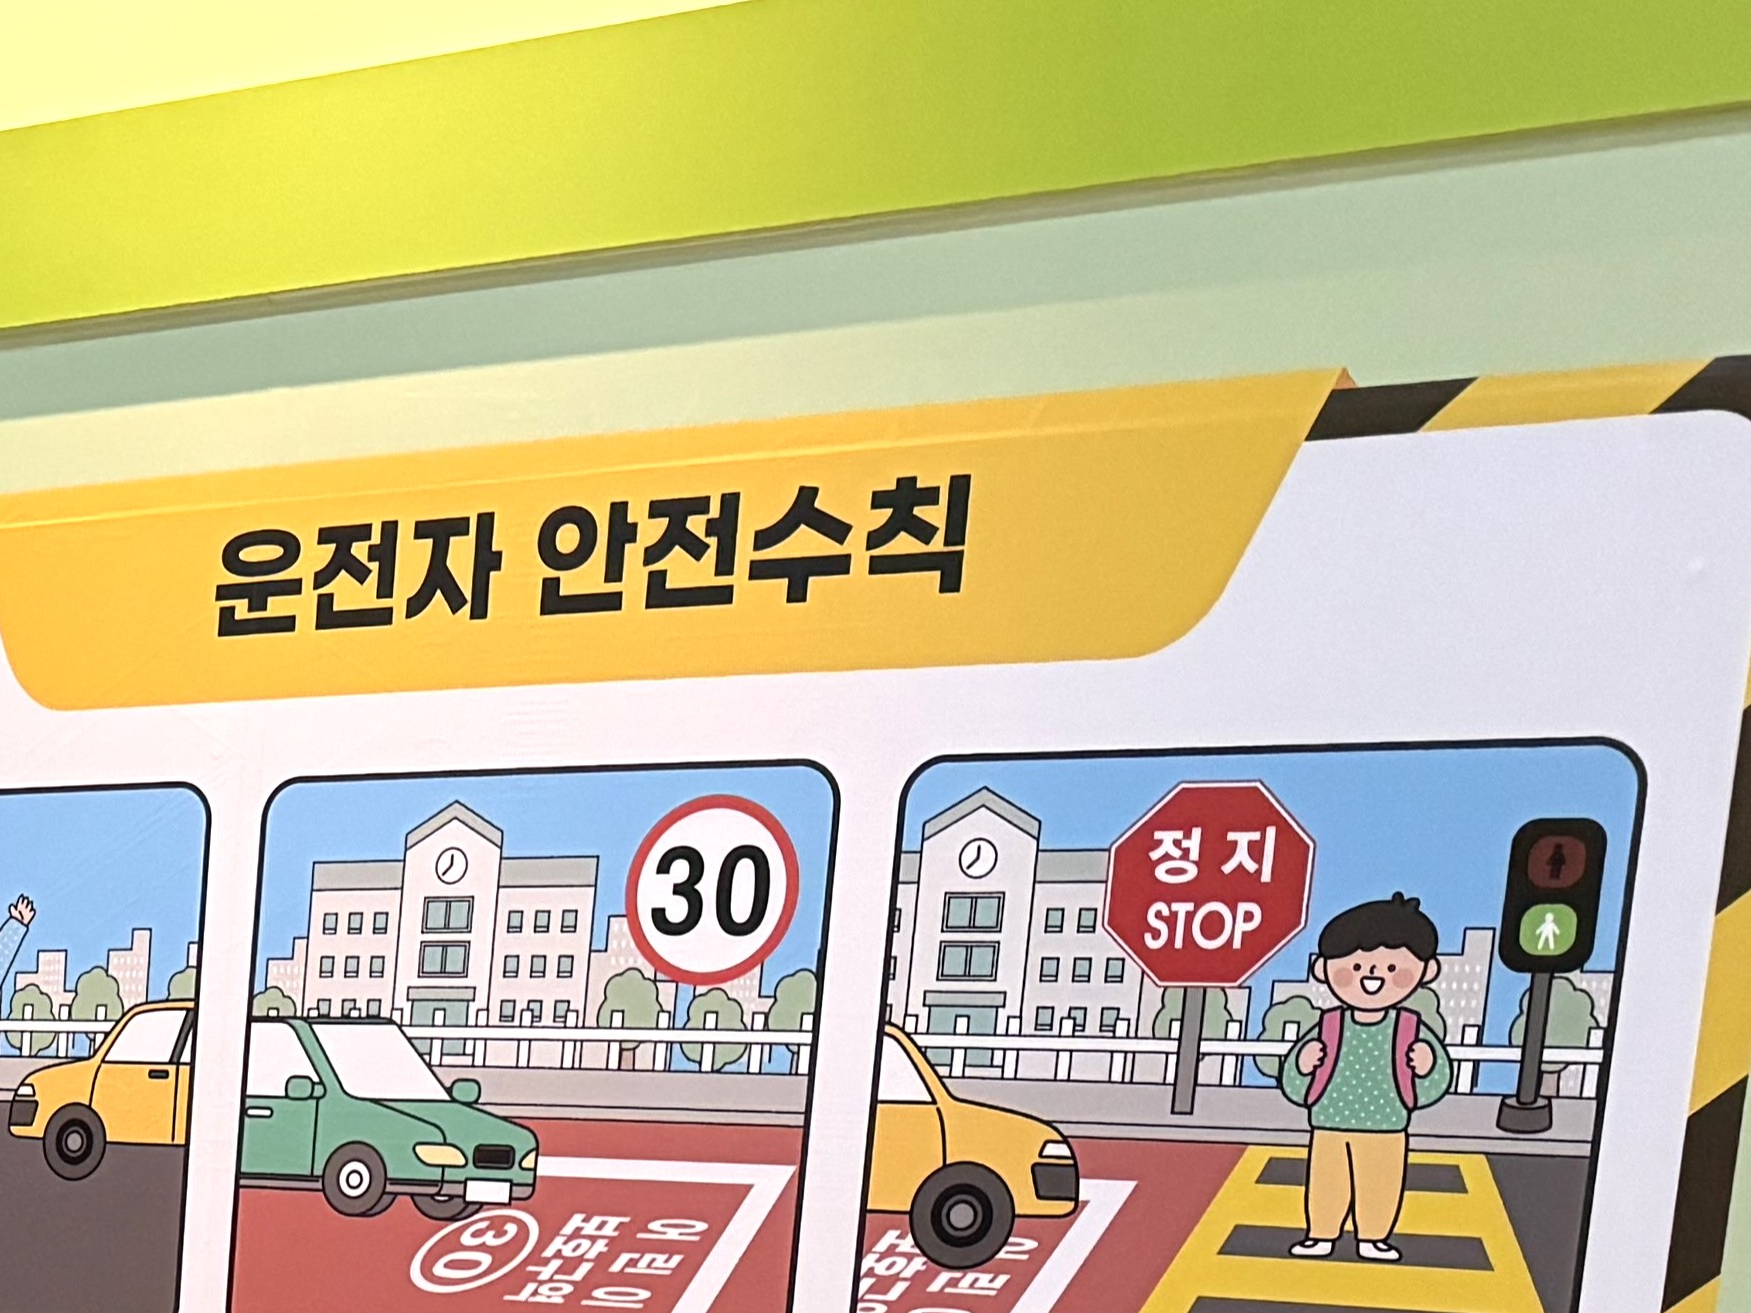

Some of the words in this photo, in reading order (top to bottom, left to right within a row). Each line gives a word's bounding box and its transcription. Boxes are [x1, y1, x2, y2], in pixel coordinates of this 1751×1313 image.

[213, 511, 503, 637] 운전자
[536, 474, 973, 617] 안전수칙
[649, 844, 770, 940] 30
[1142, 898, 1263, 951] STOP
